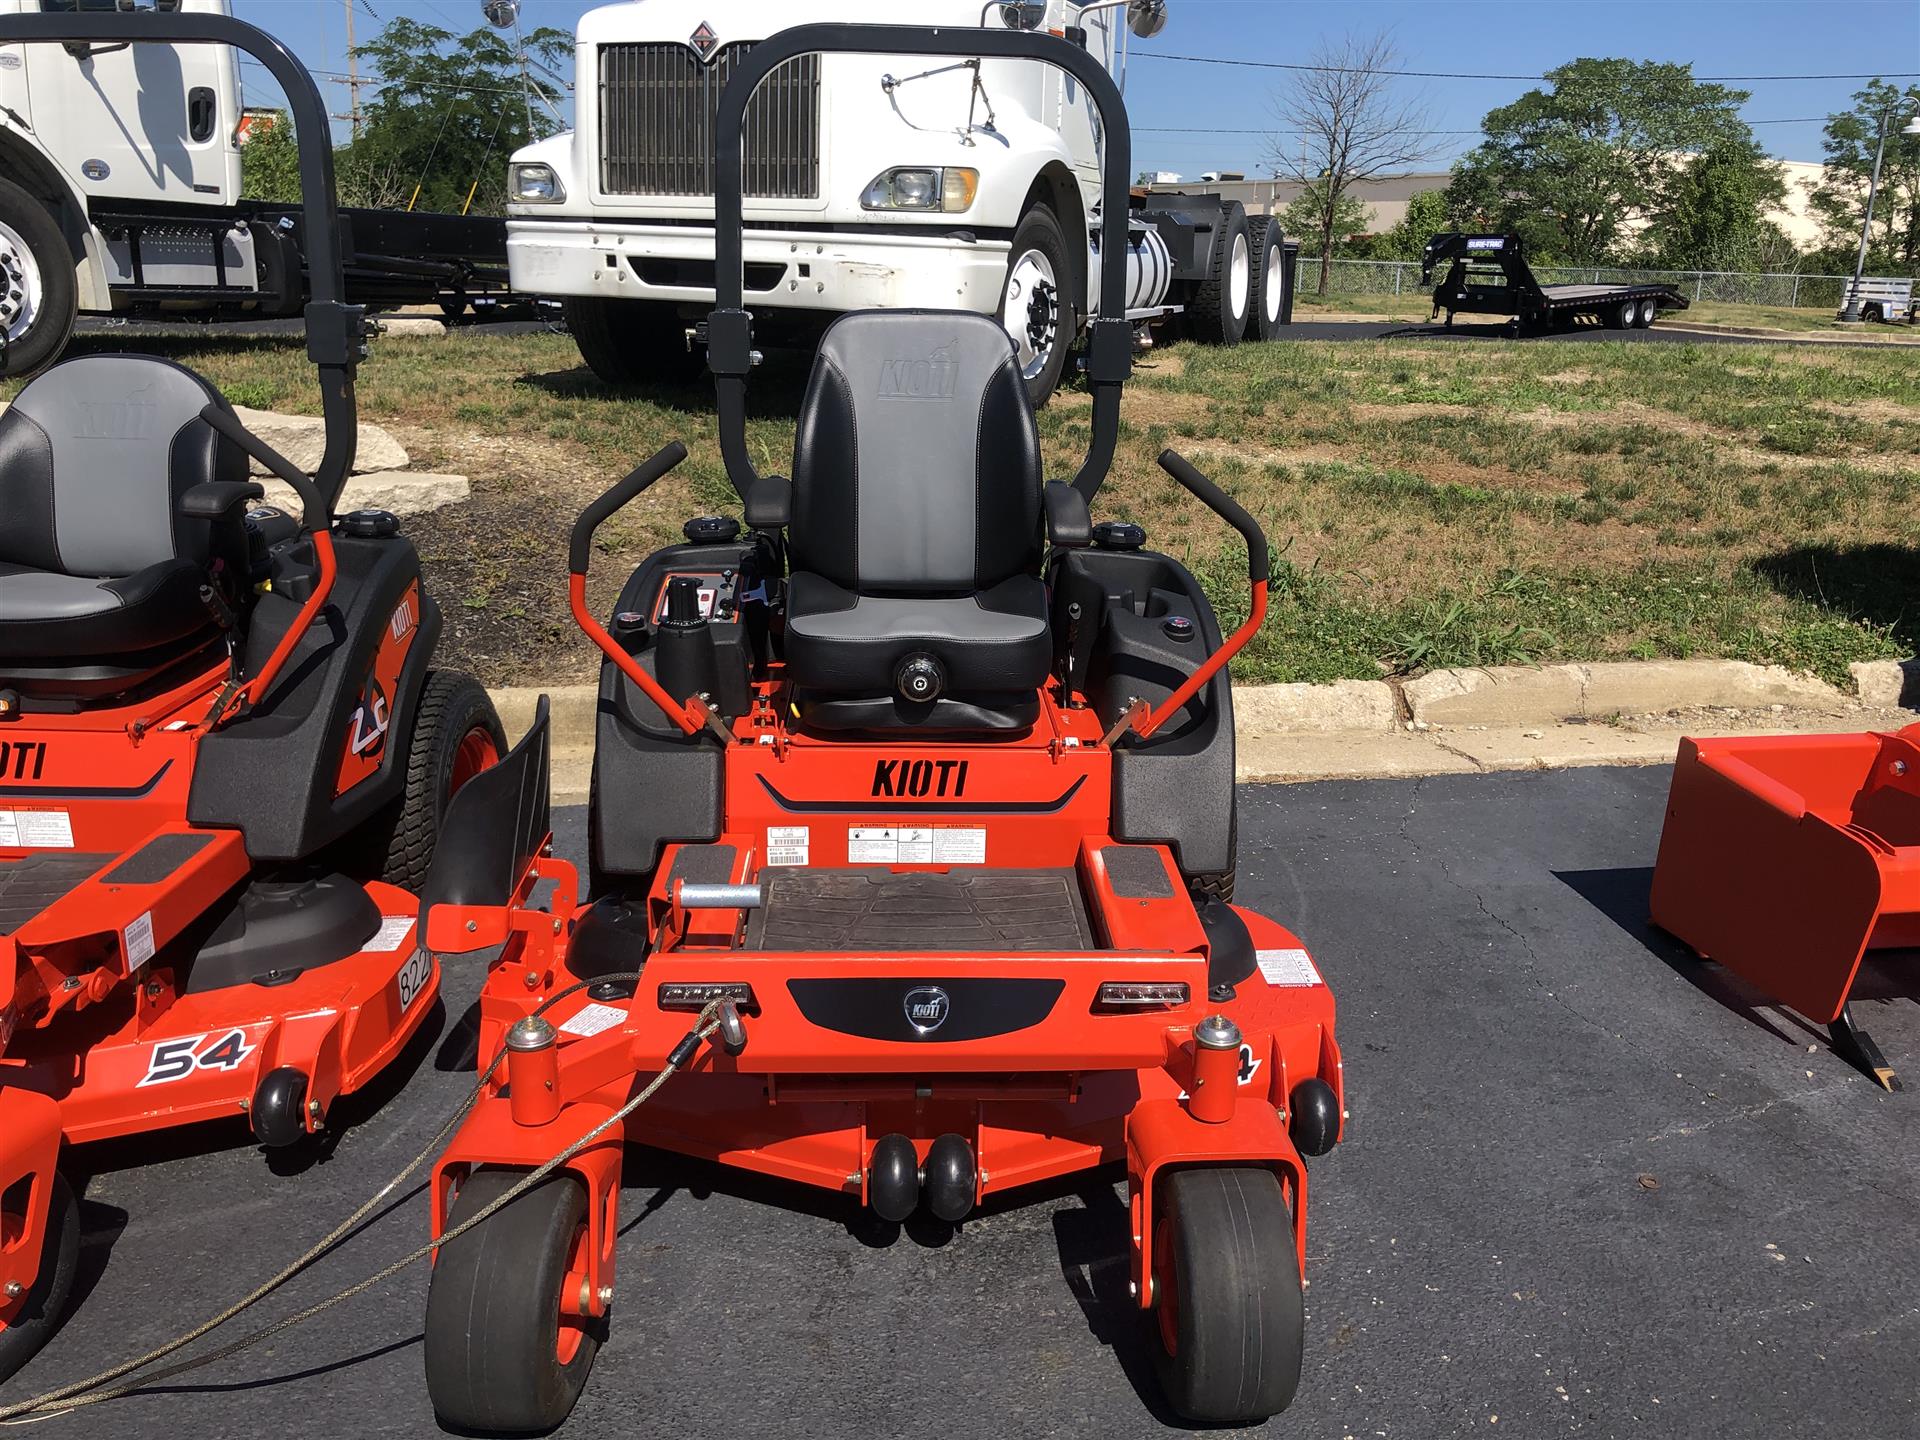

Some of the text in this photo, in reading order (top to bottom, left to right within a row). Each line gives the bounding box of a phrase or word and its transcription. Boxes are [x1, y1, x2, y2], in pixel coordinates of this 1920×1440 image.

[1468, 240, 1503, 249] SURE-TRAC
[878, 359, 961, 394] KIOTI
[391, 600, 413, 639] KIOTI
[871, 759, 969, 797] KIOTI
[912, 1003, 940, 1017] KIOTI
[135, 1028, 257, 1088] 54
